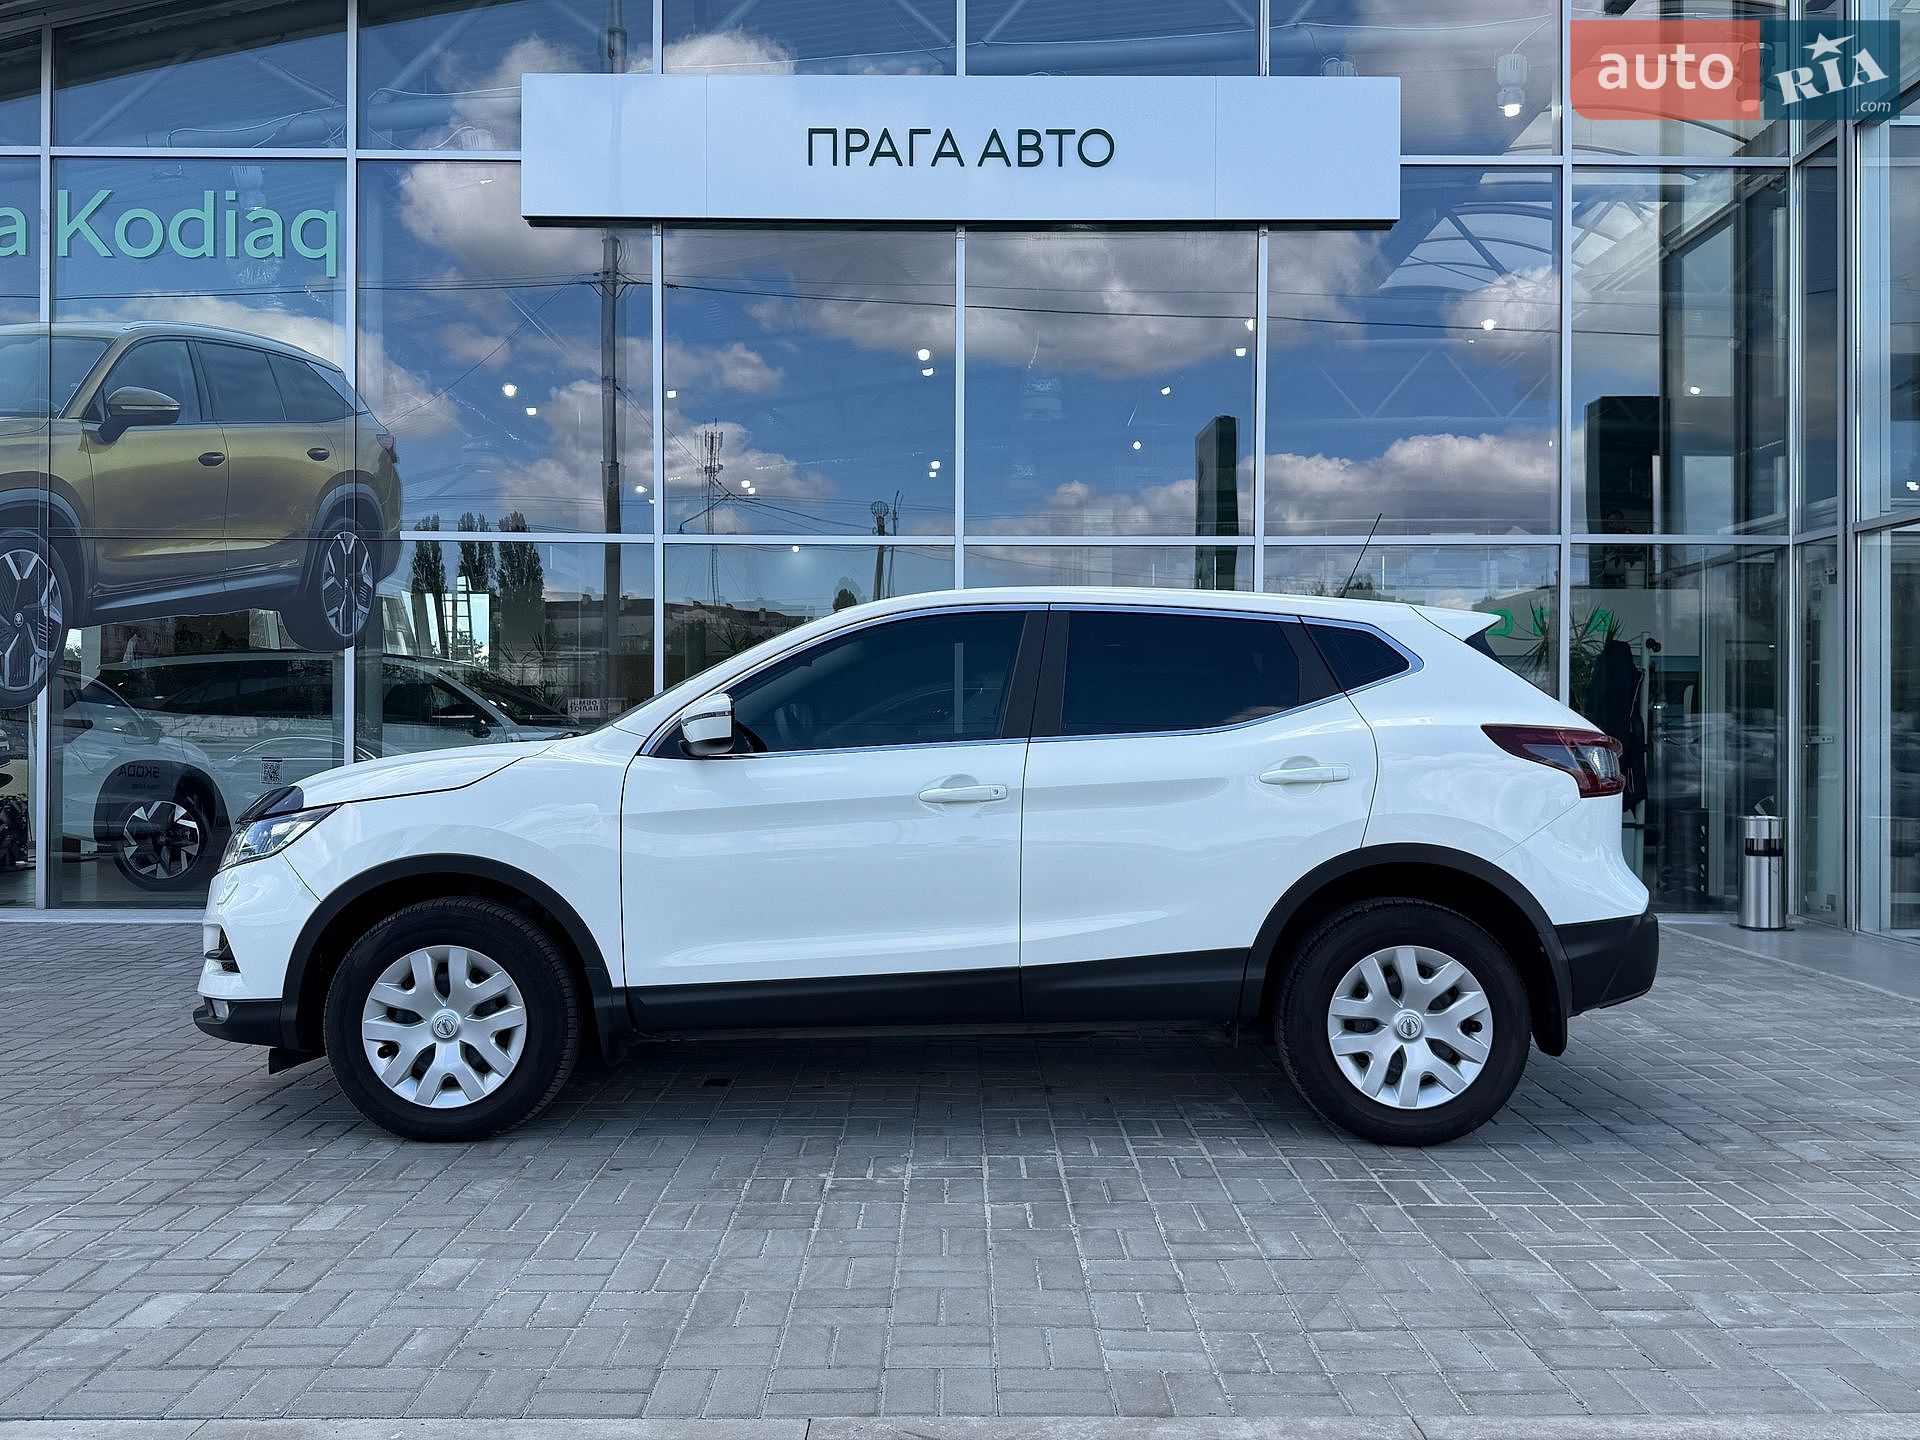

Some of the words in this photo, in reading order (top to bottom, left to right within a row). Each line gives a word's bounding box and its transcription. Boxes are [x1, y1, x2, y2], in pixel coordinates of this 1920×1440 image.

[807, 127, 965, 168] ПРАГА
[977, 127, 1115, 168] АВТО
[57, 189, 337, 278] Kodiaq
